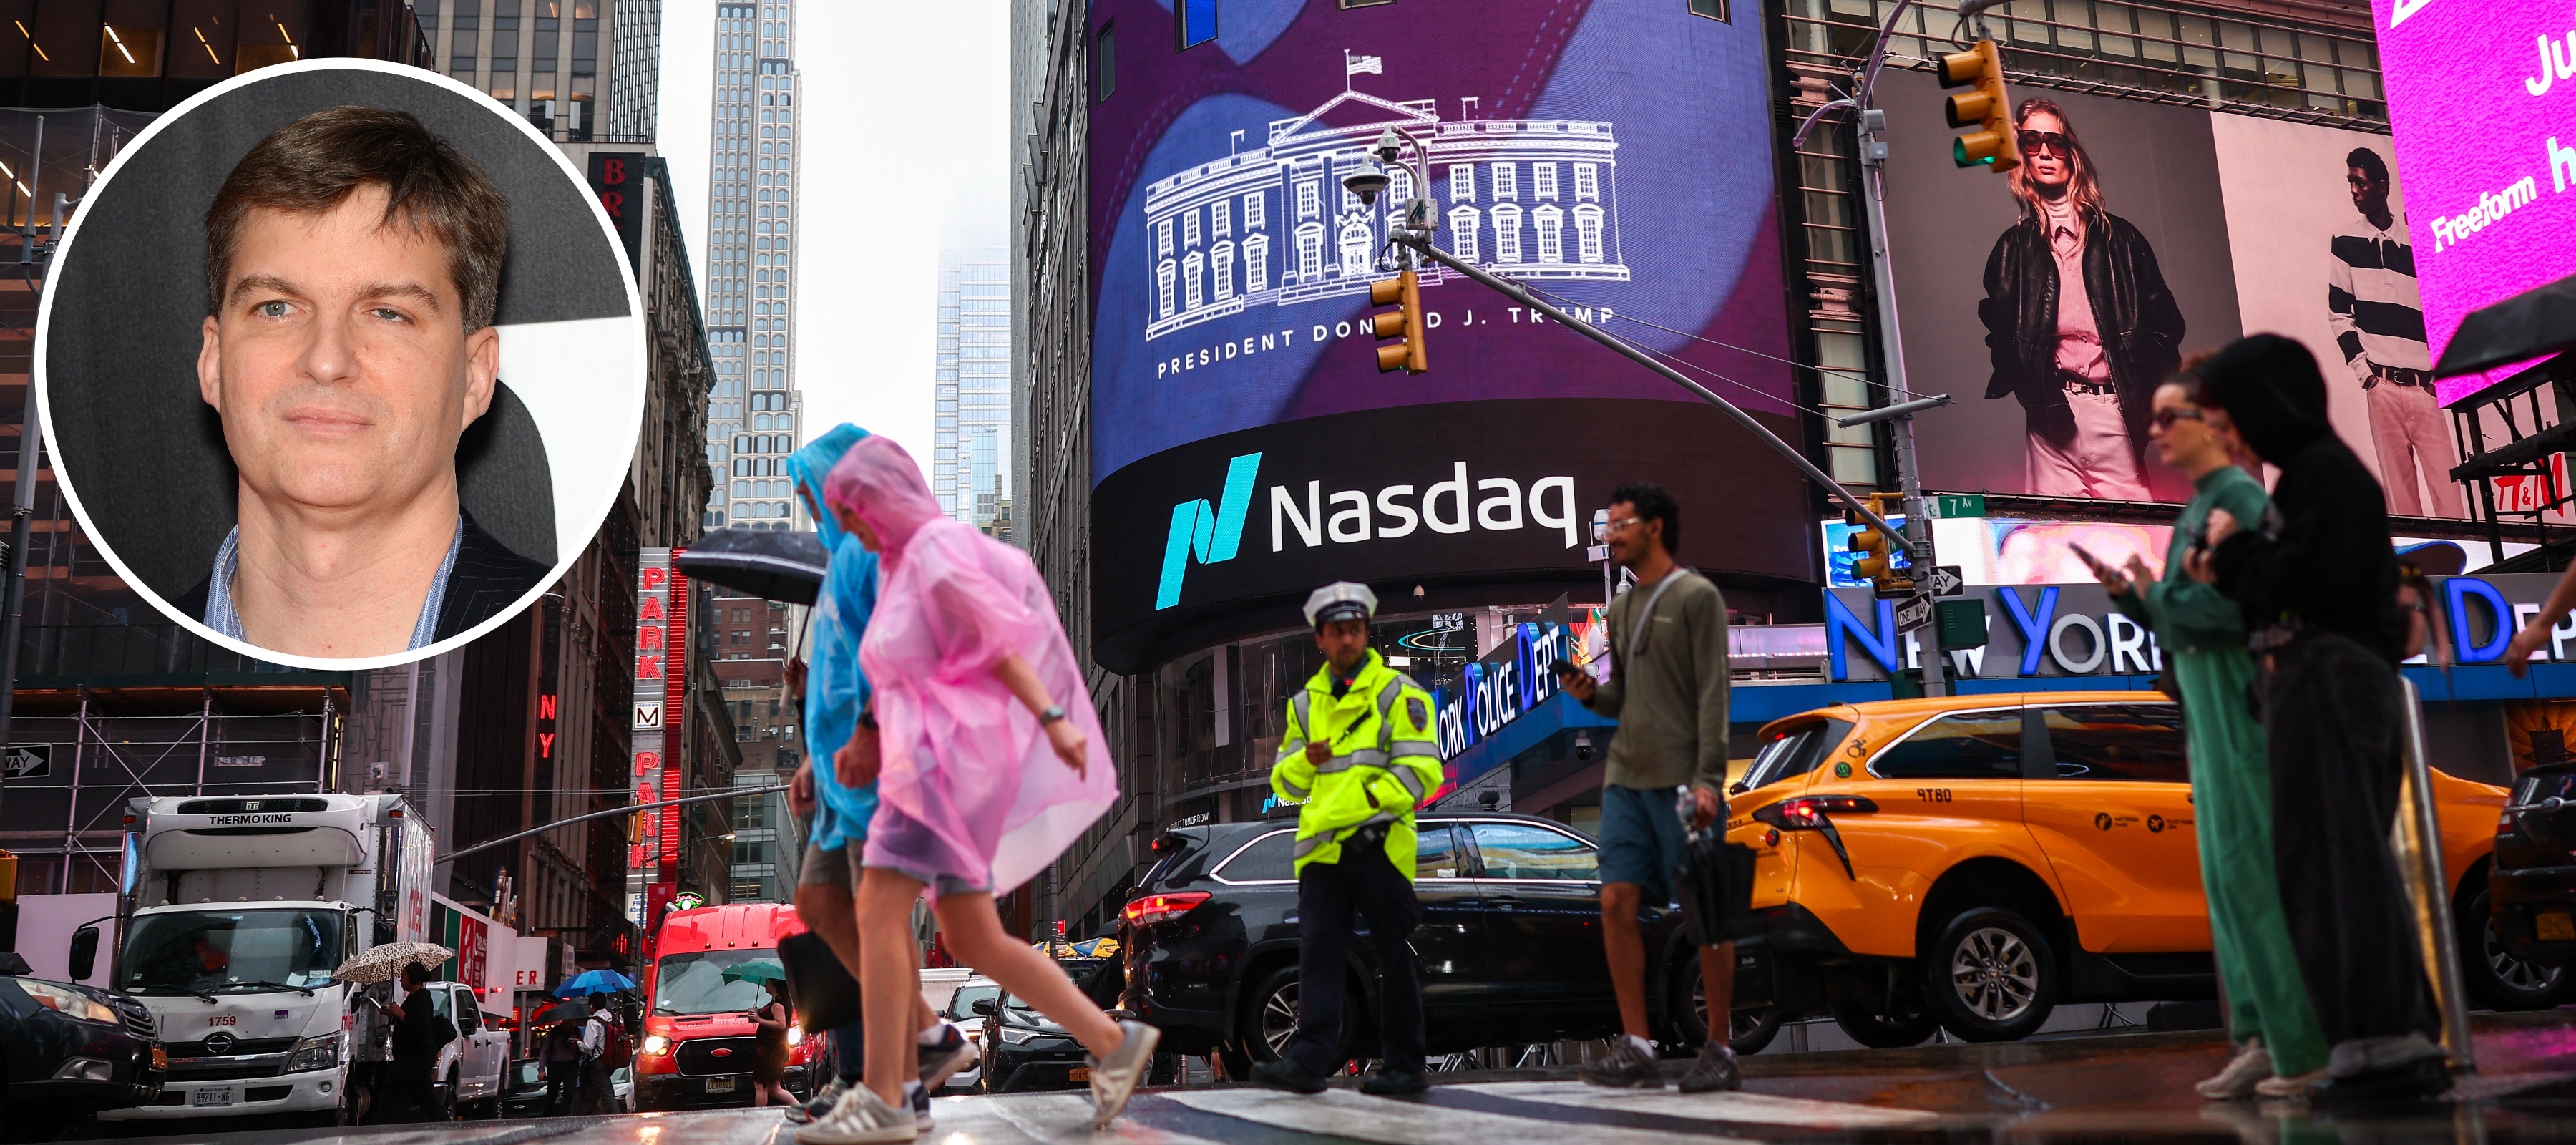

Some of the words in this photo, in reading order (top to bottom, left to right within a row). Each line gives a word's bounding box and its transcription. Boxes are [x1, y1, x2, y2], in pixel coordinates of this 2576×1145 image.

[602, 157, 625, 230] BR
[2430, 176, 2537, 253] Freeform
[1158, 329, 1294, 379] PRESIDENT
[1313, 312, 1441, 342] DOND
[1464, 309, 1486, 326] J.
[1270, 461, 1579, 552] Nasdaq
[1949, 498, 1957, 515] 7
[1963, 497, 1972, 507] Av
[1899, 613, 1911, 625] ONE
[1915, 602, 1927, 619] WAY
[1933, 575, 1951, 588] AY
[638, 567, 666, 679] PARK
[1435, 688, 1466, 761] ORK
[1464, 662, 1516, 746] POLICE
[1517, 621, 1563, 712] DEPT
[209, 815, 260, 825] THERMO
[263, 814, 292, 824] KING
[630, 751, 660, 869] PARK
[1182, 812, 1209, 827] TOMORROW
[208, 1016, 236, 1027] 1759
